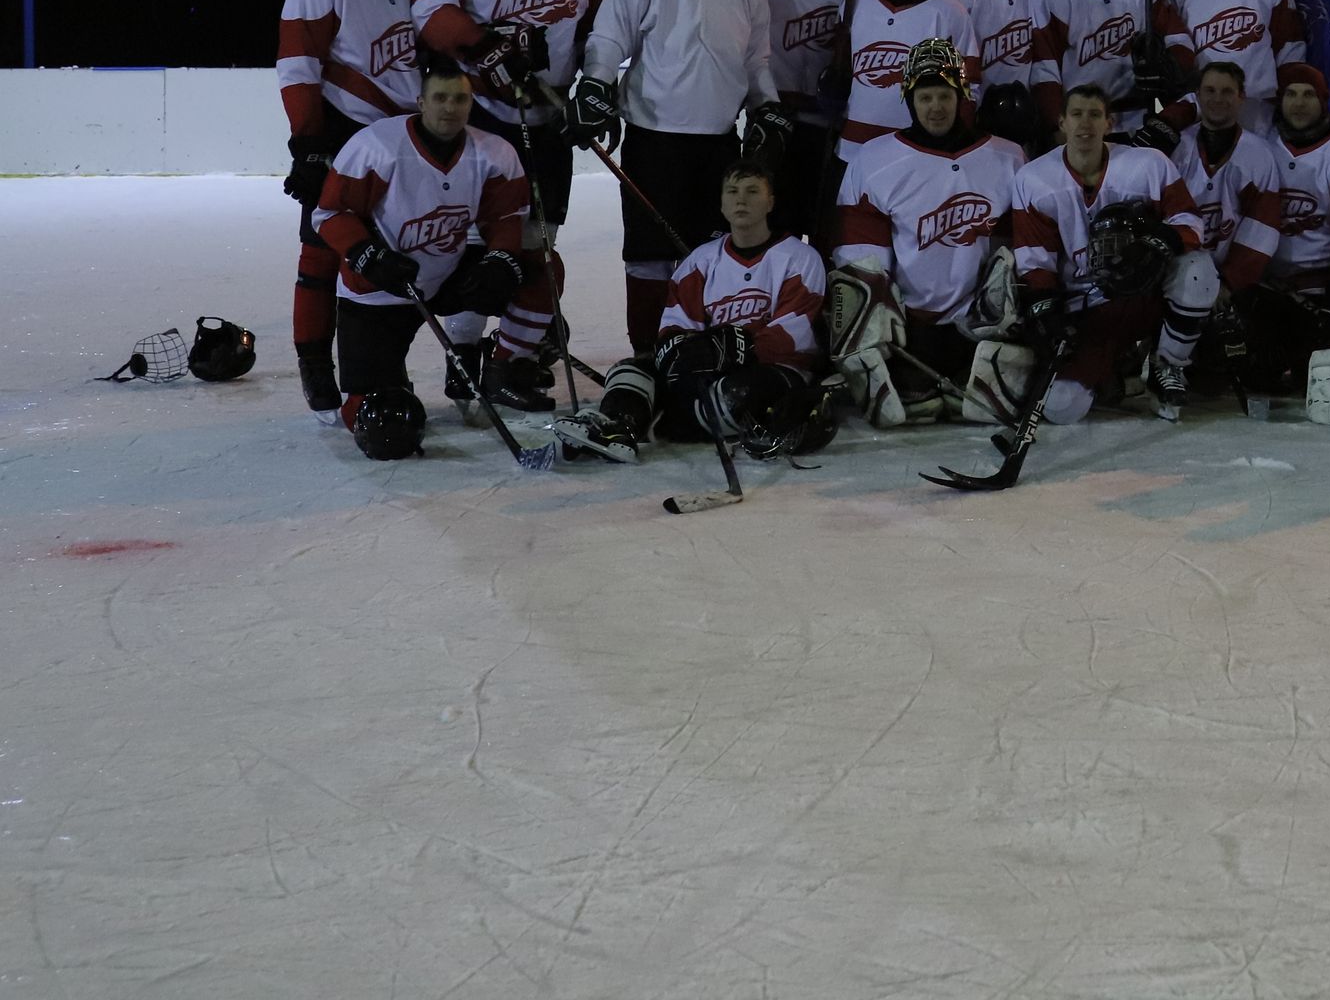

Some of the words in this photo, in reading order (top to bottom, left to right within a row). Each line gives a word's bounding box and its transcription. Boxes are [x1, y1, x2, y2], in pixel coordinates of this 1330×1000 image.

[1196, 12, 1256, 49] МЕТЕОР
[920, 203, 988, 248] МЕТЕОР
[834, 286, 843, 330] BAUER
